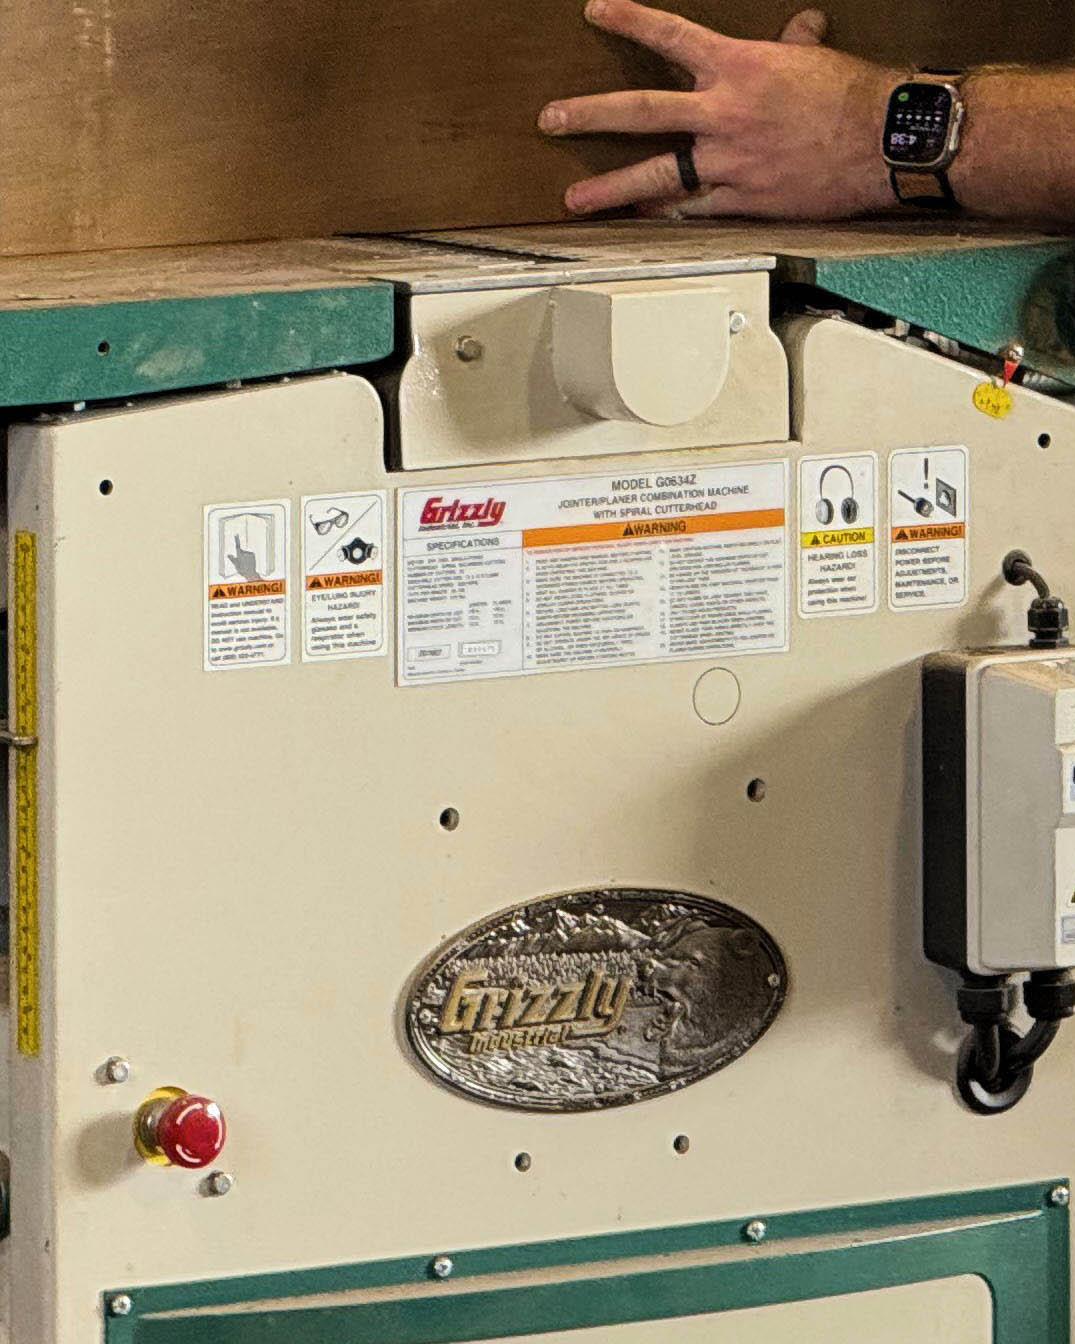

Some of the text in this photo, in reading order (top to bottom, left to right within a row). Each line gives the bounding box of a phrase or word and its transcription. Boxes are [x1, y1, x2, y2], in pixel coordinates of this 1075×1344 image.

[611, 473, 697, 492] MODEL G0634Z
[640, 488, 705, 503] COMBINATION
[707, 484, 750, 497] MACHINE
[419, 495, 507, 527] Grizzly
[593, 501, 718, 520] WITH SPIRAL CUTTERHEAD
[634, 520, 687, 536] WARNING
[908, 524, 962, 540] WARNING!
[426, 537, 500, 552] SPECIFICATIONS
[822, 530, 866, 545] CAUTION
[807, 548, 869, 562] HEARING LOSS
[323, 573, 380, 587] WARNING!
[226, 582, 283, 597] WARNING!
[440, 968, 632, 1036] Grizzly
[469, 1023, 572, 1054] Industrial
